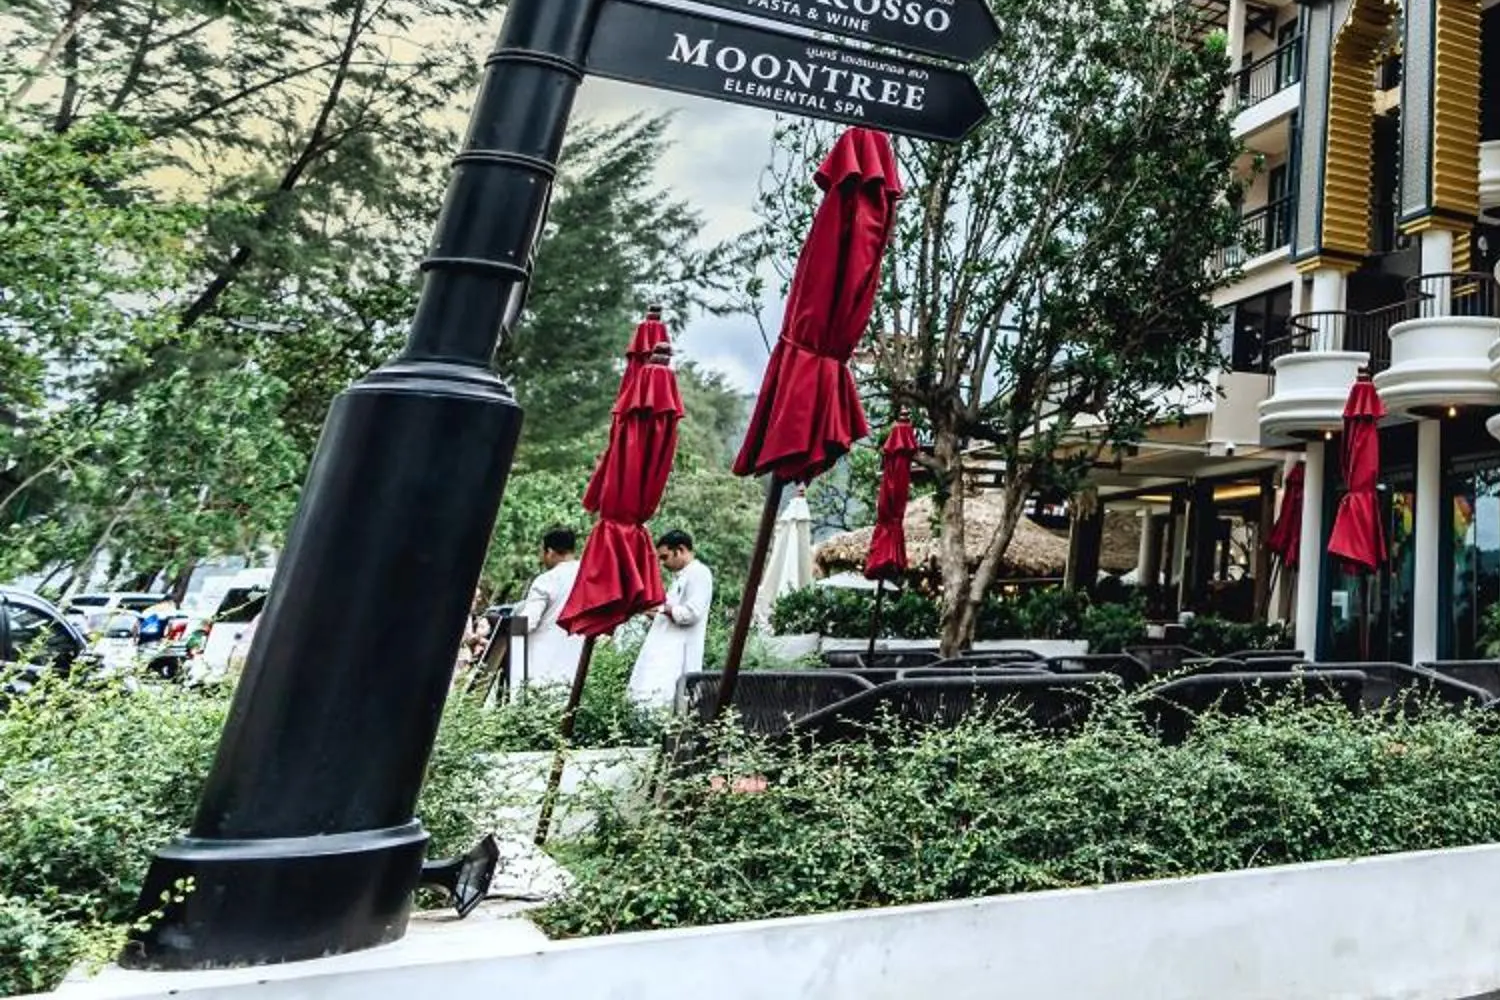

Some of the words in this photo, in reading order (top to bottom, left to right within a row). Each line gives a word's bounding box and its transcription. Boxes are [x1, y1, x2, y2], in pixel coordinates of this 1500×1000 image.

[807, 7, 819, 20] &
[826, 11, 871, 32] WINE
[666, 32, 926, 111] MOONTREE
[724, 78, 827, 111] ELEMENTAL
[833, 101, 865, 117] SPA
